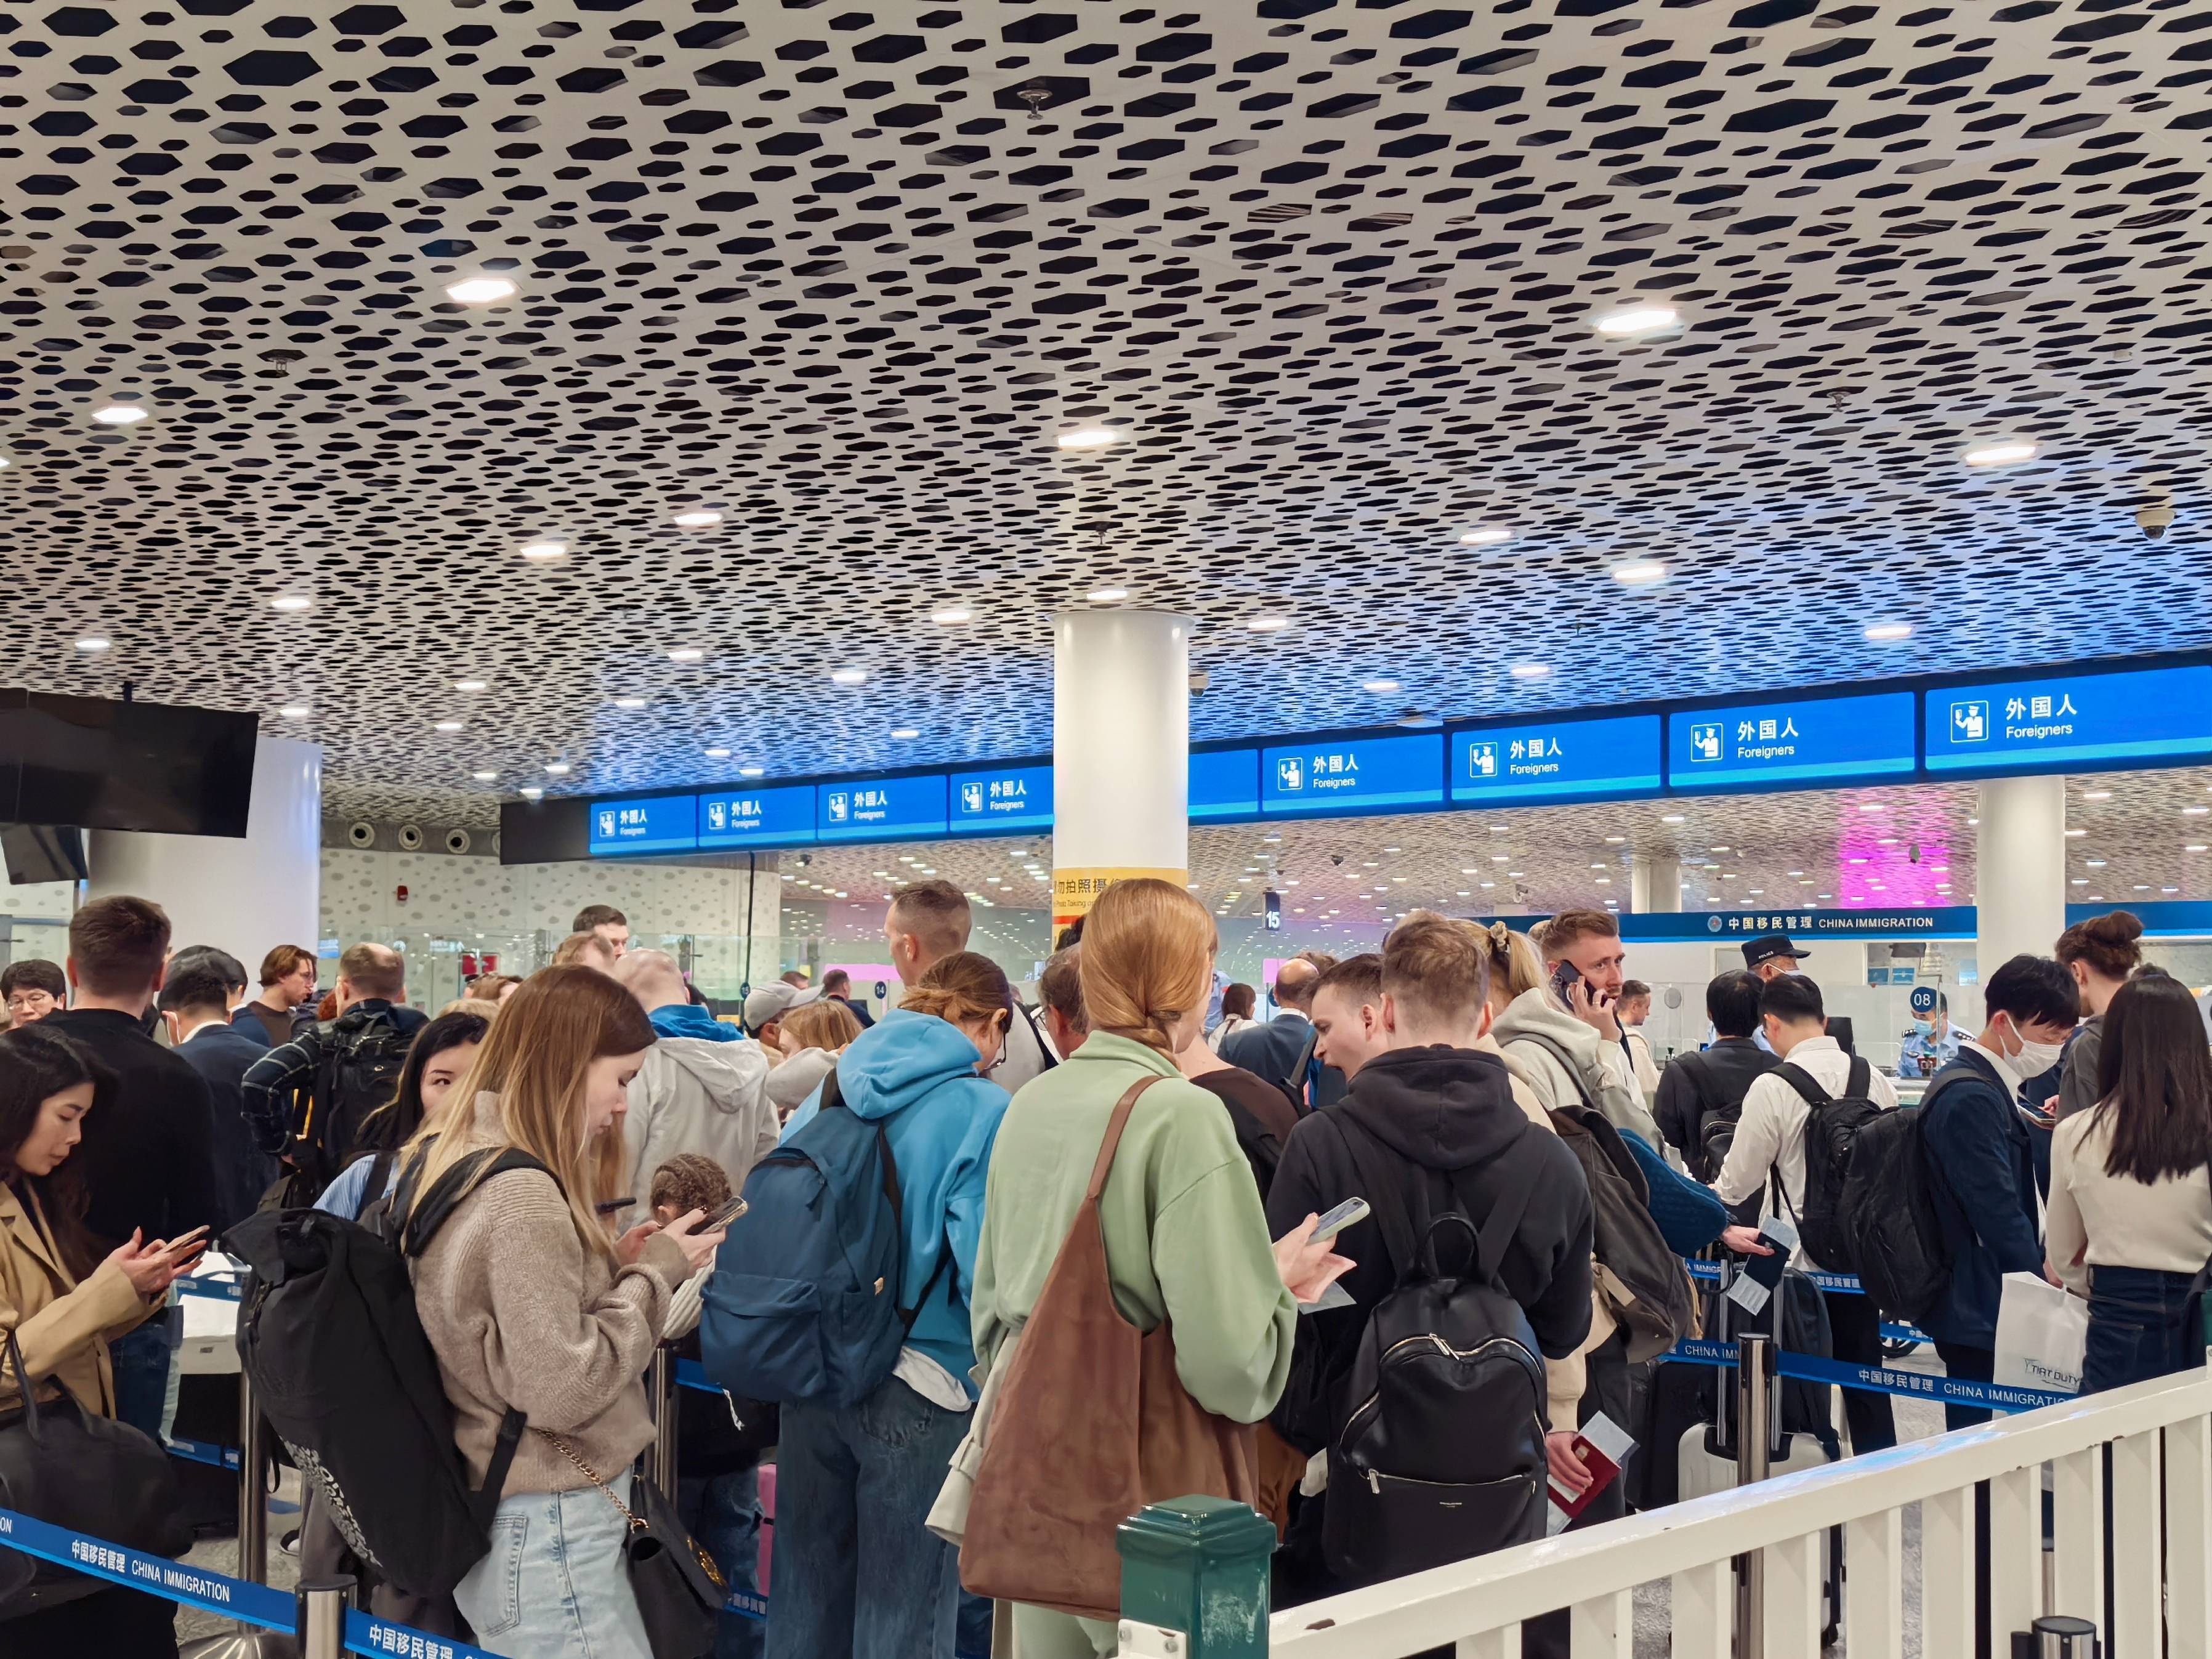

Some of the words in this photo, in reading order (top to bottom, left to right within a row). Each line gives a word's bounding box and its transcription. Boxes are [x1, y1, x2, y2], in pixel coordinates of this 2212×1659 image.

[2005, 693, 2077, 721] 外国人
[1738, 717, 1799, 741] 外国人
[2006, 724, 2073, 739] Foreigners
[1510, 737, 1562, 759] 外国人
[1738, 745, 1794, 759] Foreigners
[1313, 754, 1358, 773] 外国人
[1510, 764, 1559, 775] Foreigners
[990, 779, 1027, 797] 外国人
[1313, 778, 1356, 789] Foreigners
[854, 790, 887, 807] 外国人
[990, 801, 1025, 811] Foreigners
[731, 800, 762, 816] 外国人
[854, 811, 886, 820] Foreigners
[620, 809, 647, 825] 外国人
[732, 819, 760, 829] Foreigners
[1266, 911, 1280, 929] 15
[1729, 916, 1812, 930] 中国移民管理
[1818, 918, 1855, 928] CHINA
[1855, 917, 1933, 927] IMMIGRATION
[876, 985, 884, 995] 14
[1913, 993, 1931, 1006] 08
[1685, 1345, 1719, 1357] CHINA
[1859, 1368, 1934, 1392] 中国移民管理
[1944, 1383, 1984, 1399] CHINA
[71, 1540, 126, 1573] 中国移民管理
[132, 1559, 160, 1582] CHINA
[164, 1568, 230, 1602] IMMIGRATION
